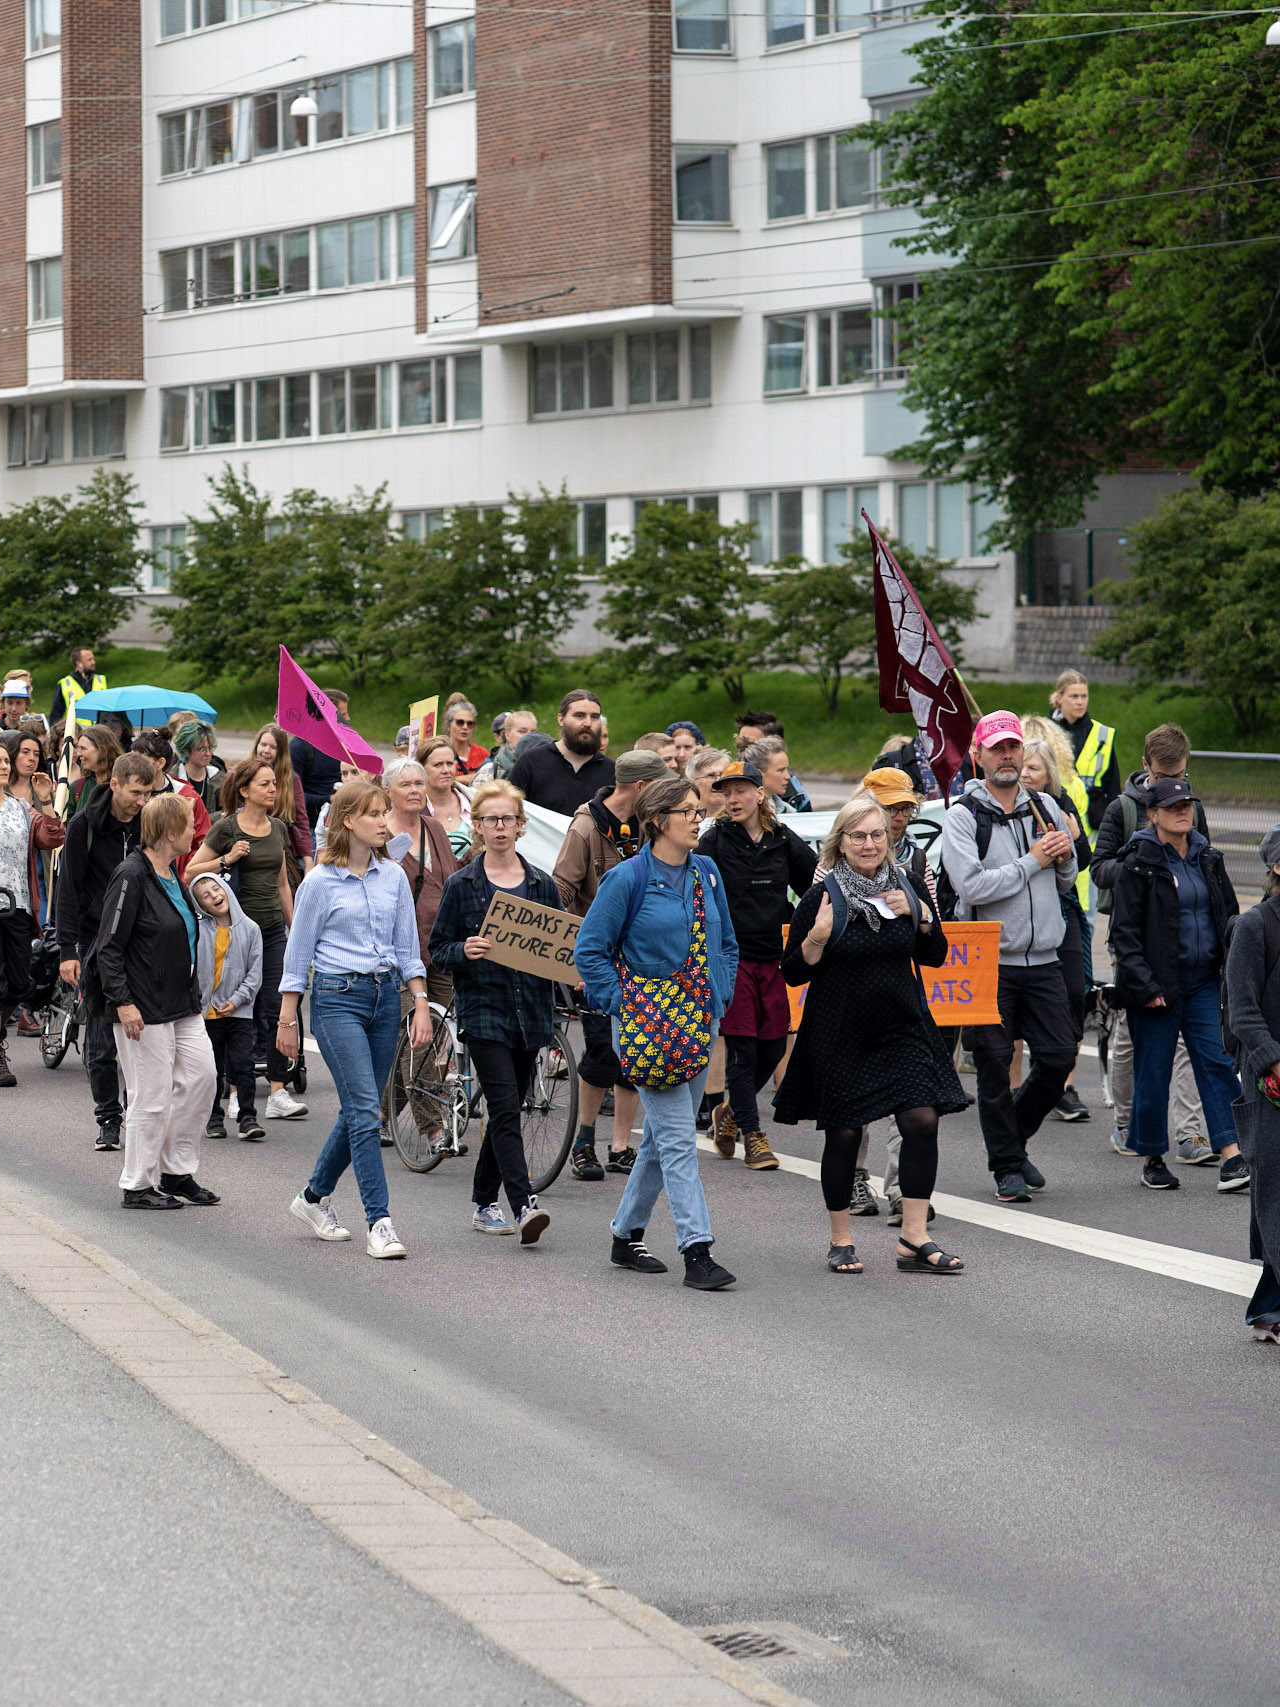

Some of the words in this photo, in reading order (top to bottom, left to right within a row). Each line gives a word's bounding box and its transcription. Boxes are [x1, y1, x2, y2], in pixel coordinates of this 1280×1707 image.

[490, 900, 563, 934] FRIDAYS
[481, 923, 554, 959] FUTURE
[927, 978, 973, 1004] ATS
